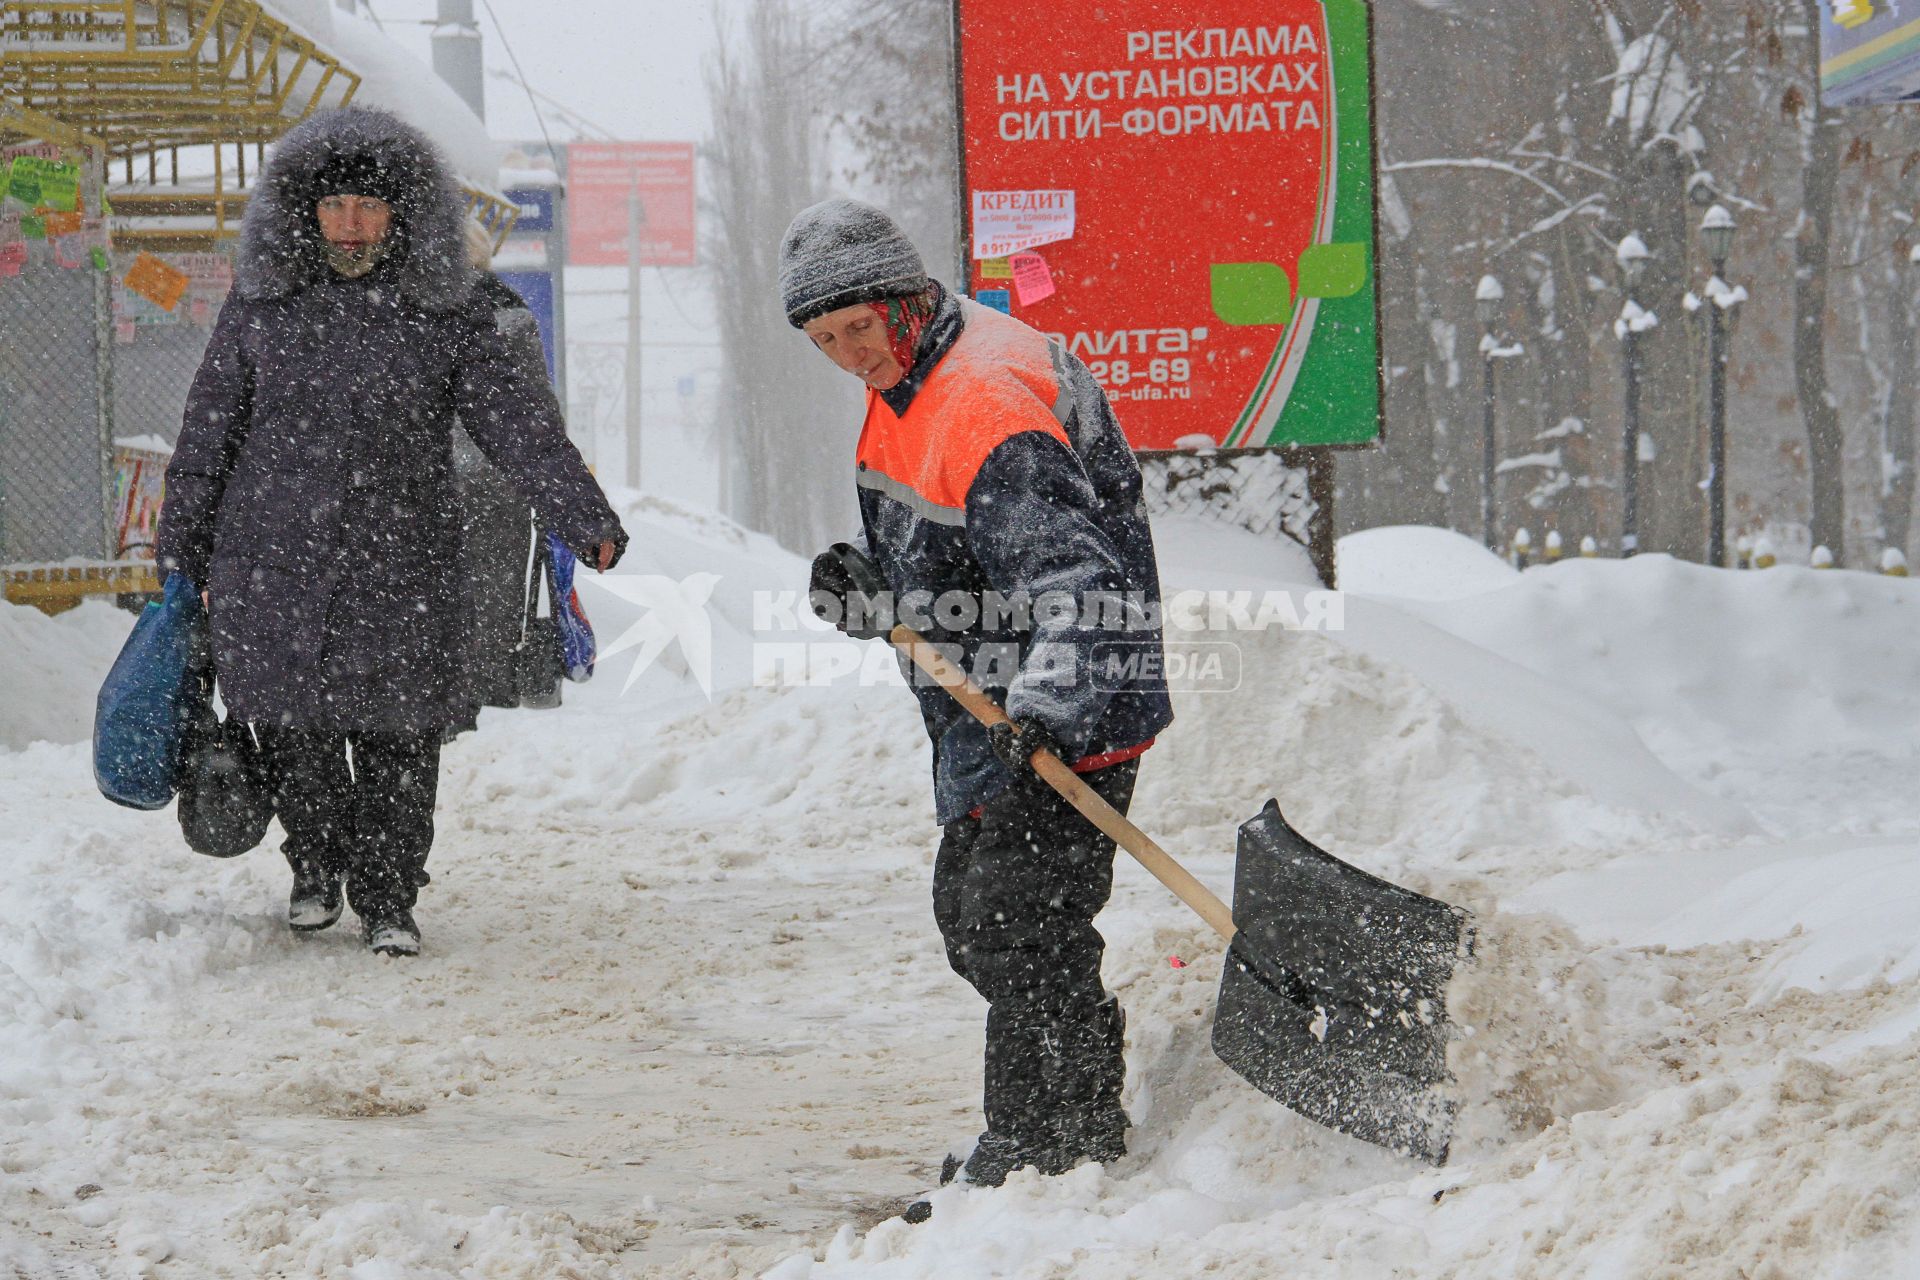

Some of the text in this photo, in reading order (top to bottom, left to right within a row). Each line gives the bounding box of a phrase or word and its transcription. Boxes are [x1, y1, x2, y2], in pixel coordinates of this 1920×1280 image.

[1127, 25, 1319, 61] РЕКЛАМА
[996, 63, 1319, 104] НА УСТАНОВКАХ
[998, 101, 1321, 141] СИТИ-ФОРМАТА
[981, 192, 1068, 212] КРЕДИТ
[981, 243, 988, 255] 8
[991, 242, 1012, 254] 917
[1106, 384, 1191, 402] a-ufa.ru
